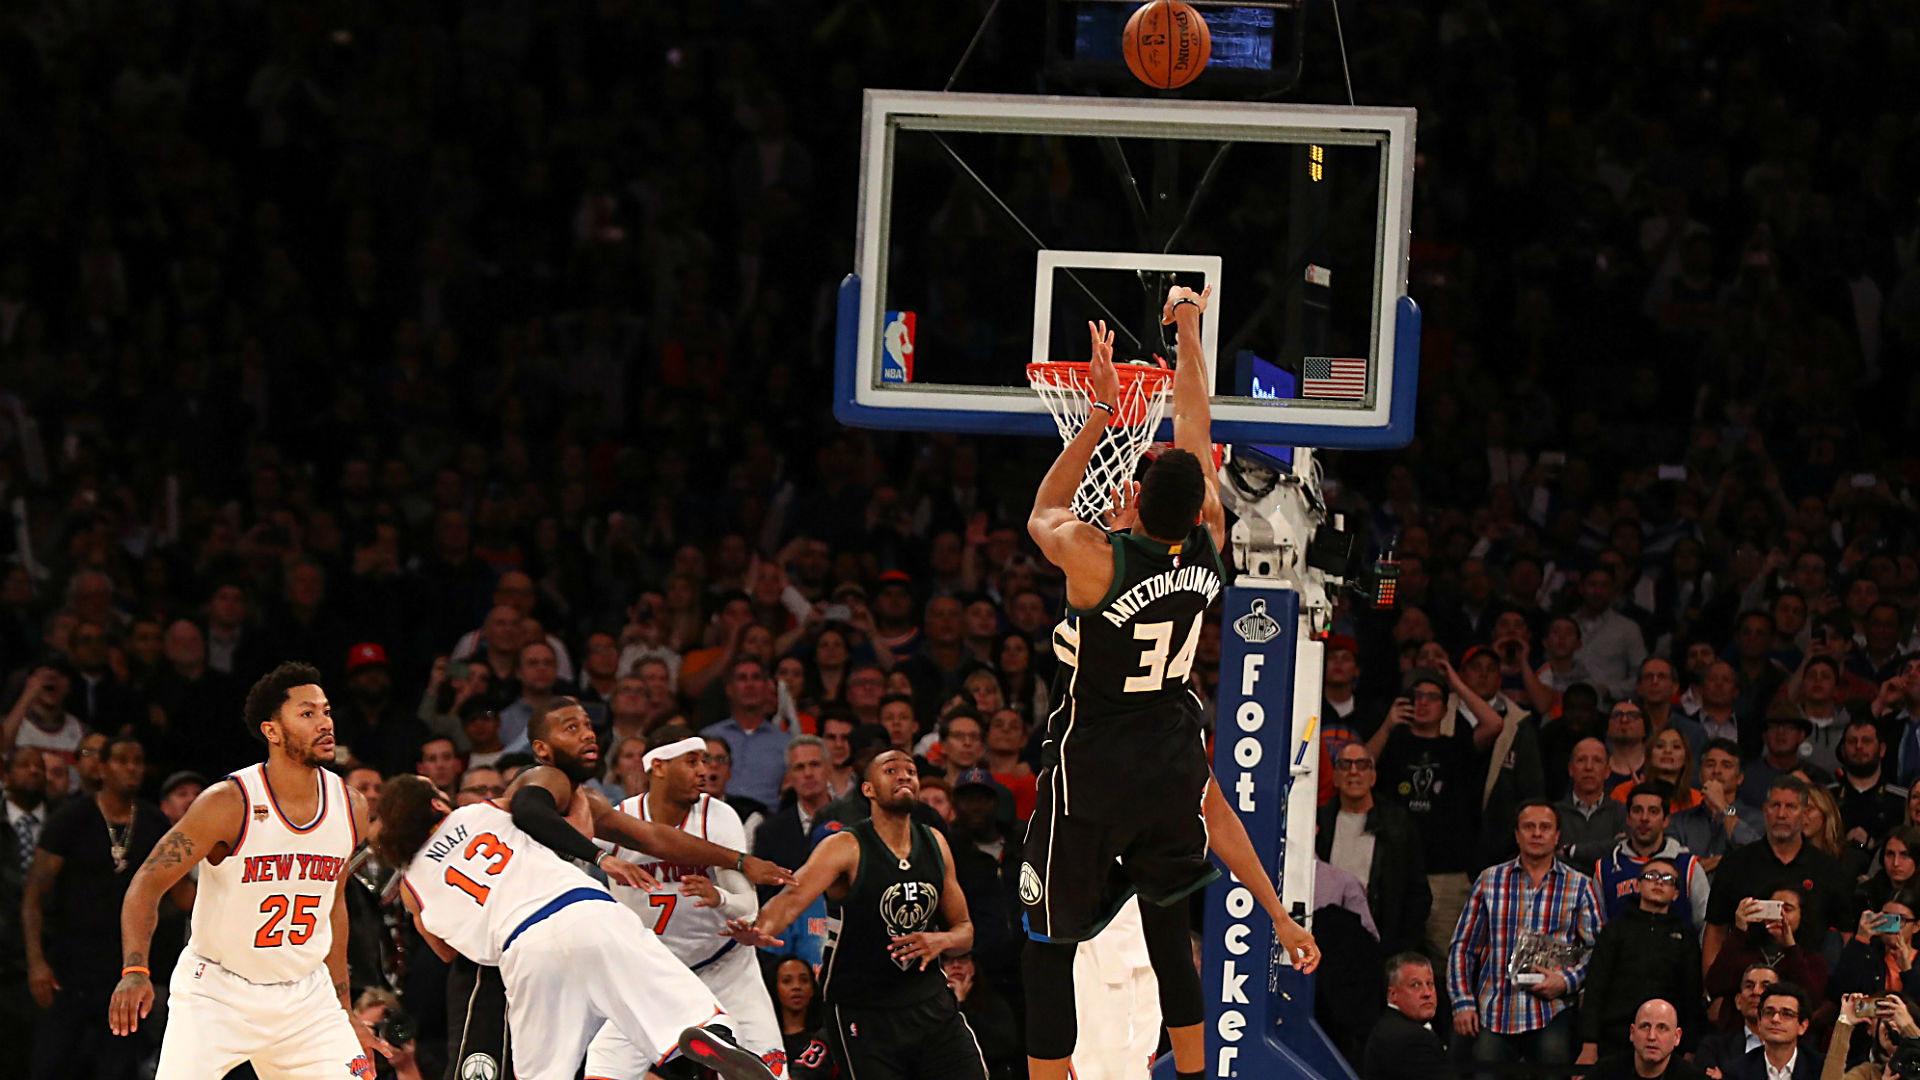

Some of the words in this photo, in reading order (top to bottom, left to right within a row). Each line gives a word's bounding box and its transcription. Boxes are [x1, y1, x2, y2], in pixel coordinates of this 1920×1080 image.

[1172, 11, 1190, 71] SPALDING
[884, 368, 903, 379] NBA
[1123, 610, 1204, 693] 34
[1234, 653, 1265, 812] Foot
[425, 824, 468, 863] NOAH
[241, 854, 294, 883] NEW
[296, 853, 345, 882] YORK
[444, 832, 514, 907] 13
[903, 882, 918, 901] 12
[254, 894, 322, 948] 25
[649, 893, 677, 935] 7
[808, 918, 827, 935] NE
[1217, 871, 1255, 1078] ocker
